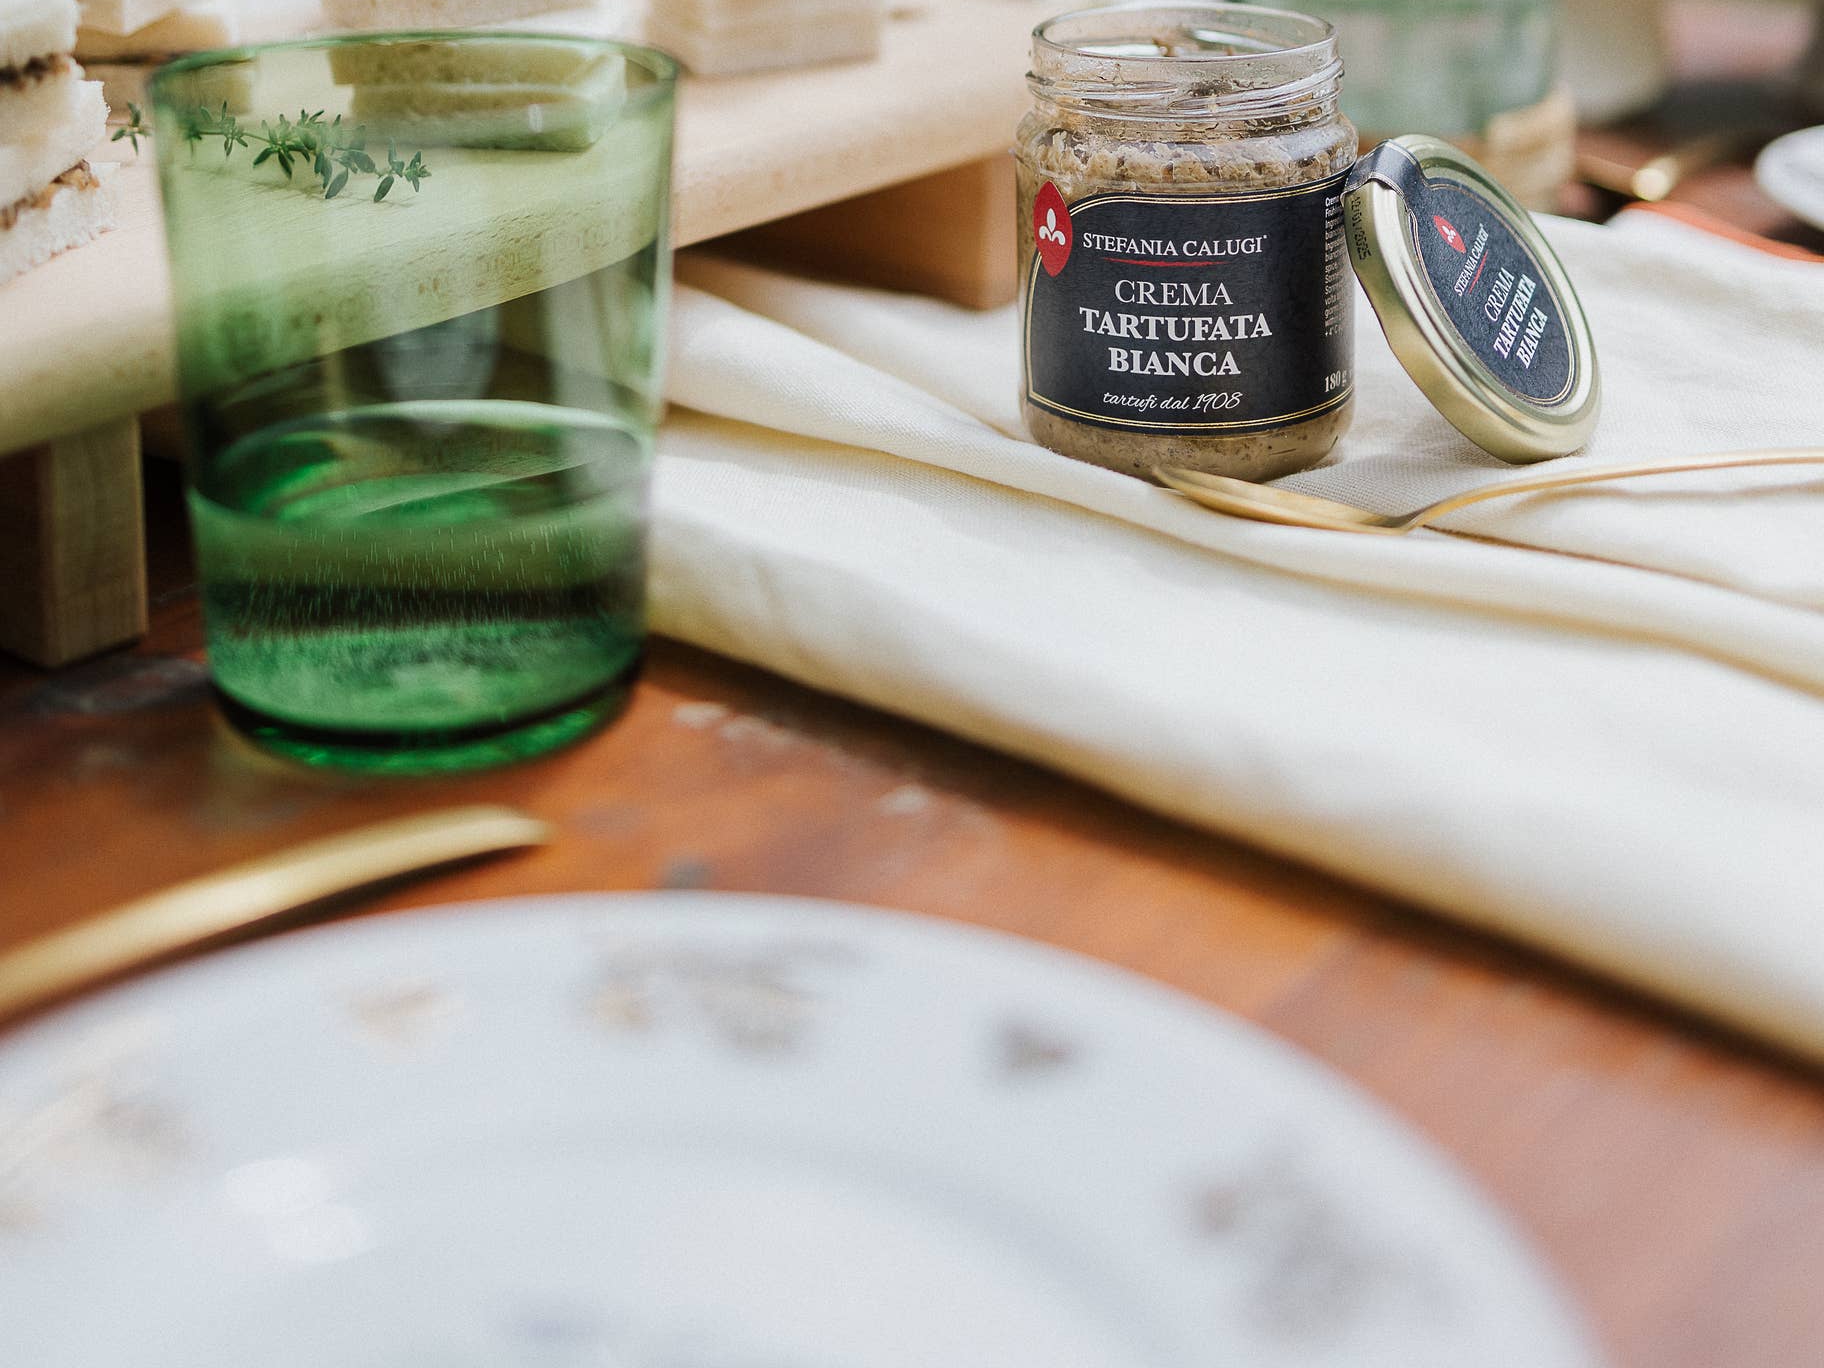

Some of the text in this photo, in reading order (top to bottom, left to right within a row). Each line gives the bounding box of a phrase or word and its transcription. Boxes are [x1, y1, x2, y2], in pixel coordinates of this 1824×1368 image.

[1083, 232, 1178, 257] STEFANIA
[1114, 279, 1234, 306] CREMA
[1454, 258, 1478, 297] STEFANIA
[1485, 266, 1515, 323] CREMA
[1079, 306, 1273, 341] TARTUFATA
[1493, 273, 1537, 359] TARTUFATA
[1516, 306, 1548, 369] BIANCA
[1108, 347, 1241, 376] BIANCA
[1324, 370, 1341, 393] 180
[1102, 391, 1243, 413] tartufi dal 1908
